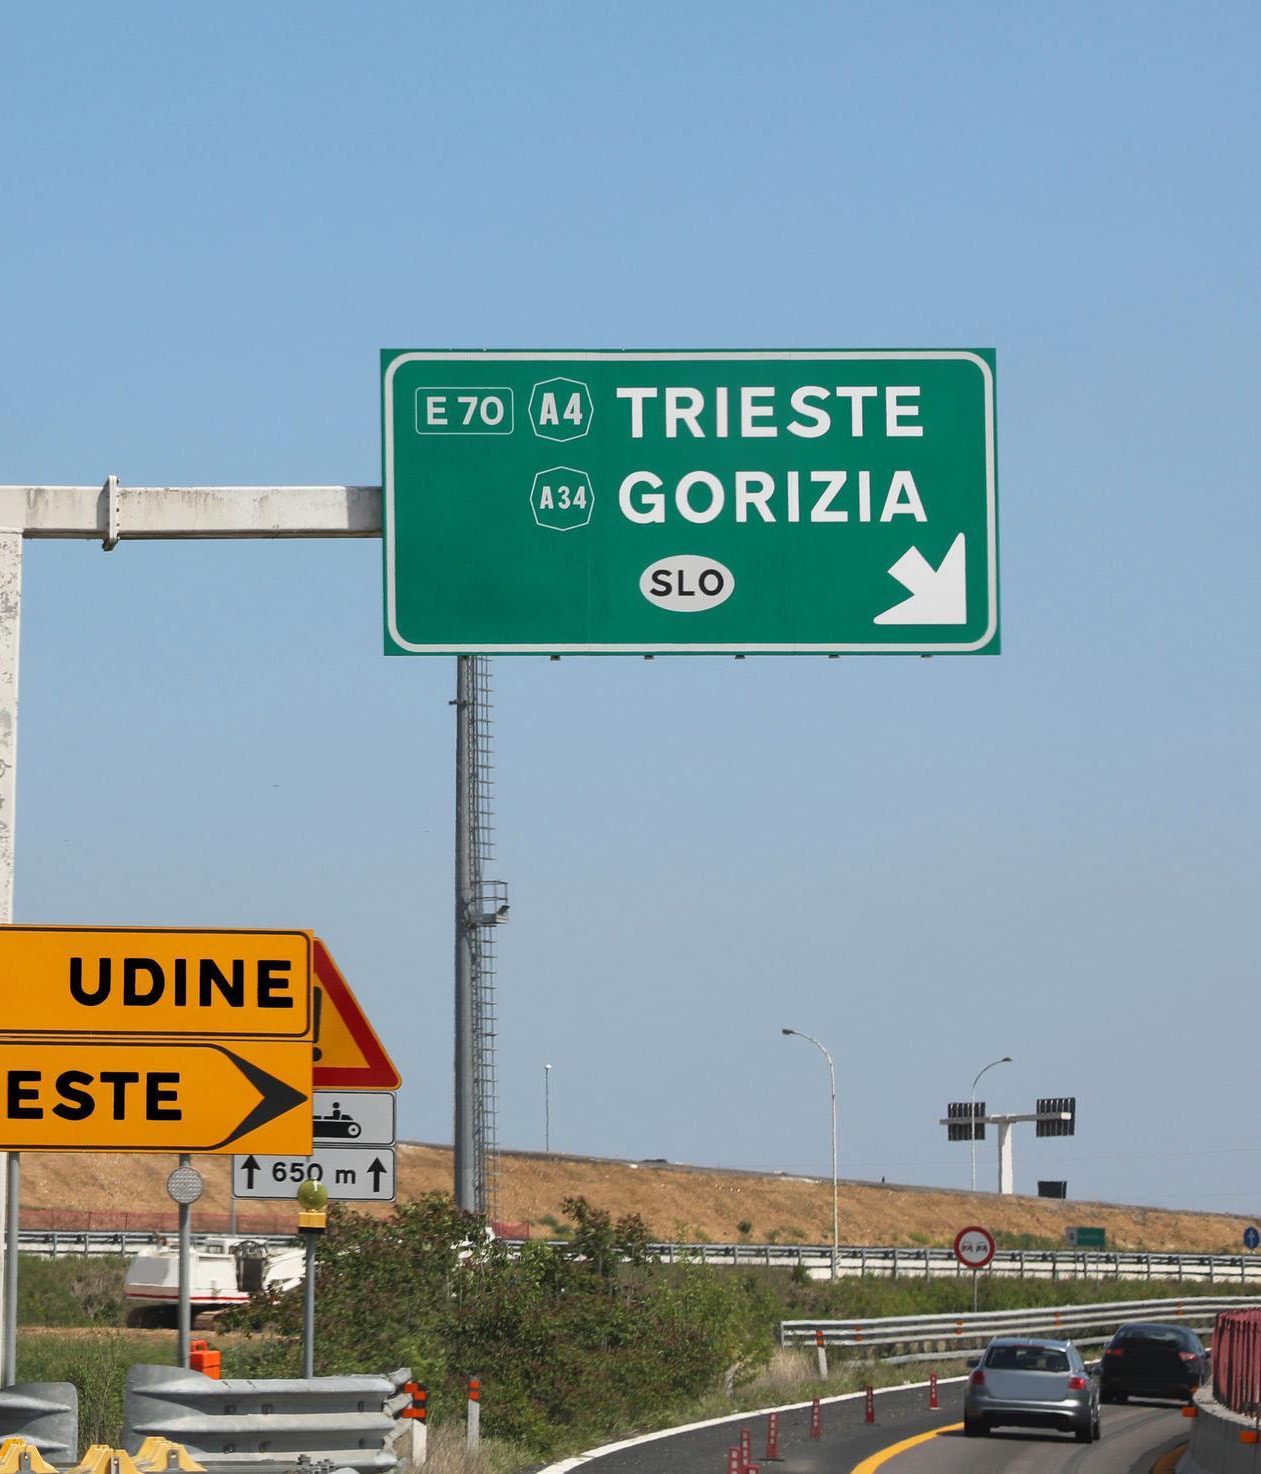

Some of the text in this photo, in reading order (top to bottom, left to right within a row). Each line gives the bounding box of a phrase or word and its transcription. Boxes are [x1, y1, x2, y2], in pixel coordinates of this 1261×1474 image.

[427, 396, 504, 425] E 70
[617, 386, 923, 438] TRIESTE
[619, 471, 927, 523] GORIZIA
[650, 569, 724, 597] SLO
[70, 958, 293, 1008] UDINE
[272, 1162, 356, 1184] 650 m
